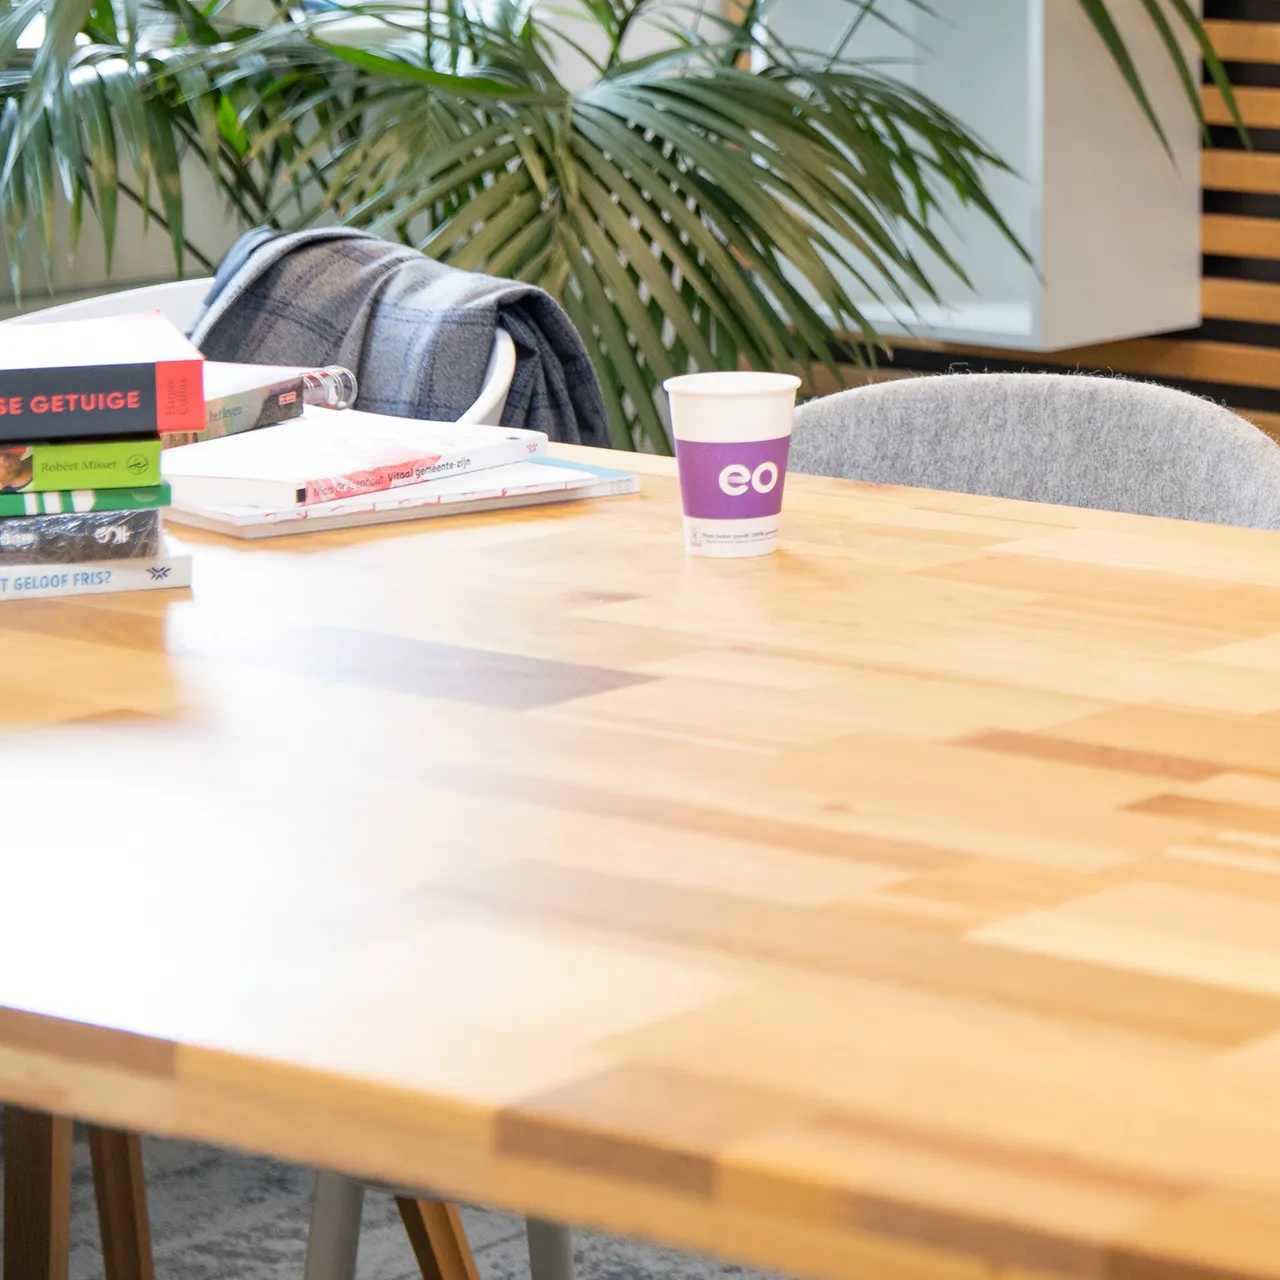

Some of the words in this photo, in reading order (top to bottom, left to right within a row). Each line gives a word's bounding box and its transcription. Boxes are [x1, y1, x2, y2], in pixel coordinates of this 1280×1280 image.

[30, 390, 141, 415] GETUIGE
[165, 379, 177, 416] Harper
[176, 377, 188, 416] Collins
[81, 459, 117, 471] Misset
[313, 486, 334, 497] Nico
[387, 468, 414, 483] Vitaal
[415, 457, 472, 478] gemeente-zijn
[718, 461, 779, 496] eo
[13, 573, 69, 592] GELOOF
[73, 570, 112, 587] FRIS?
